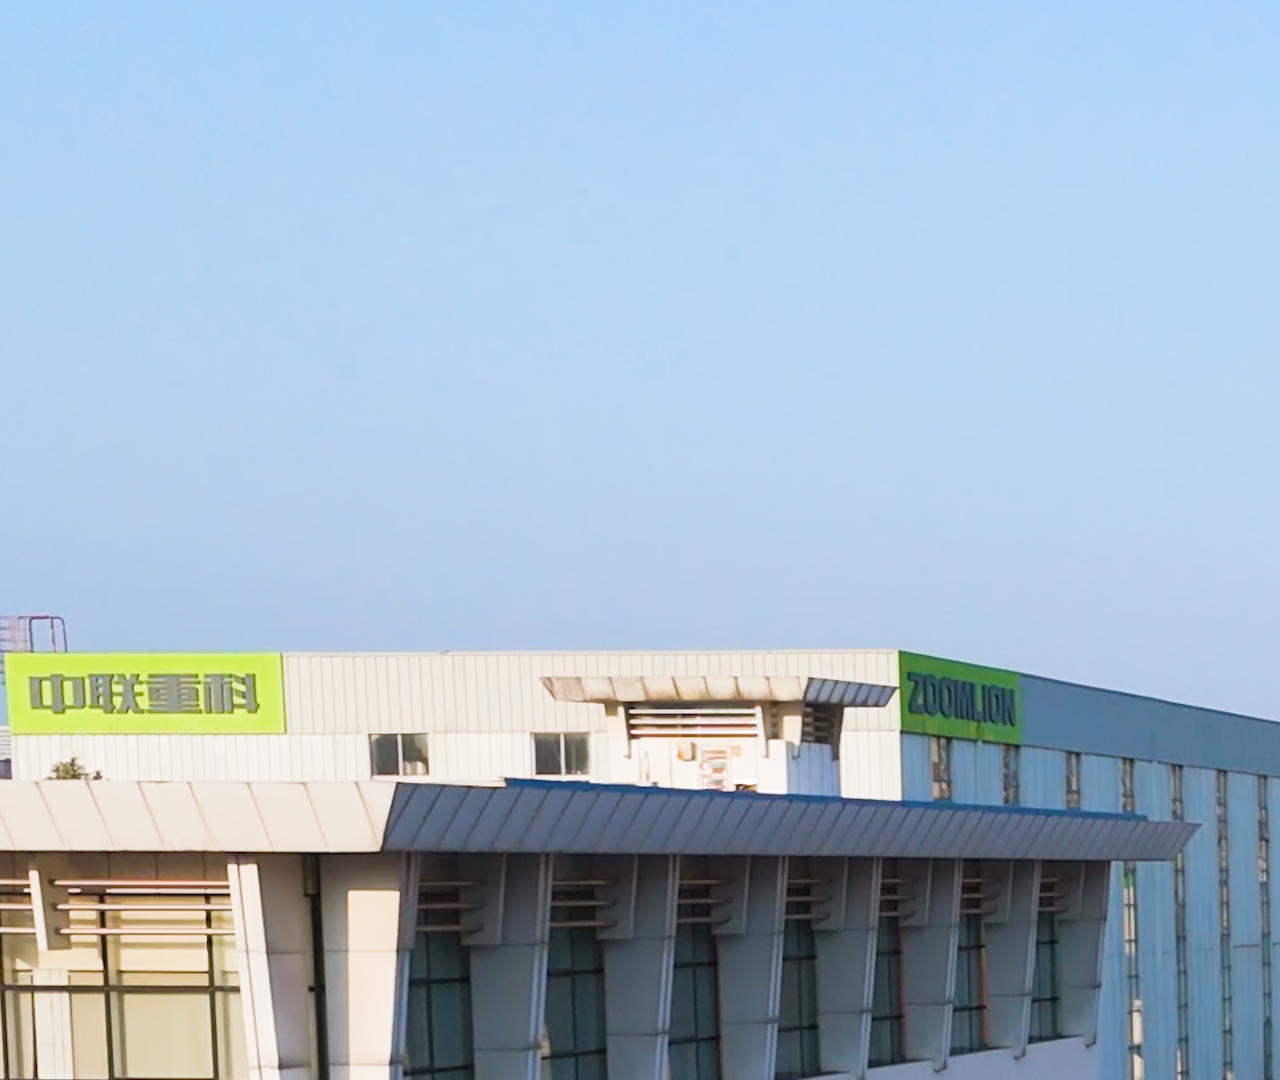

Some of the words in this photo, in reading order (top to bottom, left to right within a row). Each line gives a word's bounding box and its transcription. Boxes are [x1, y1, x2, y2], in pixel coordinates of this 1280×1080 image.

[28, 673, 260, 714] 中联重科
[906, 671, 1017, 727] ZOOMLION
